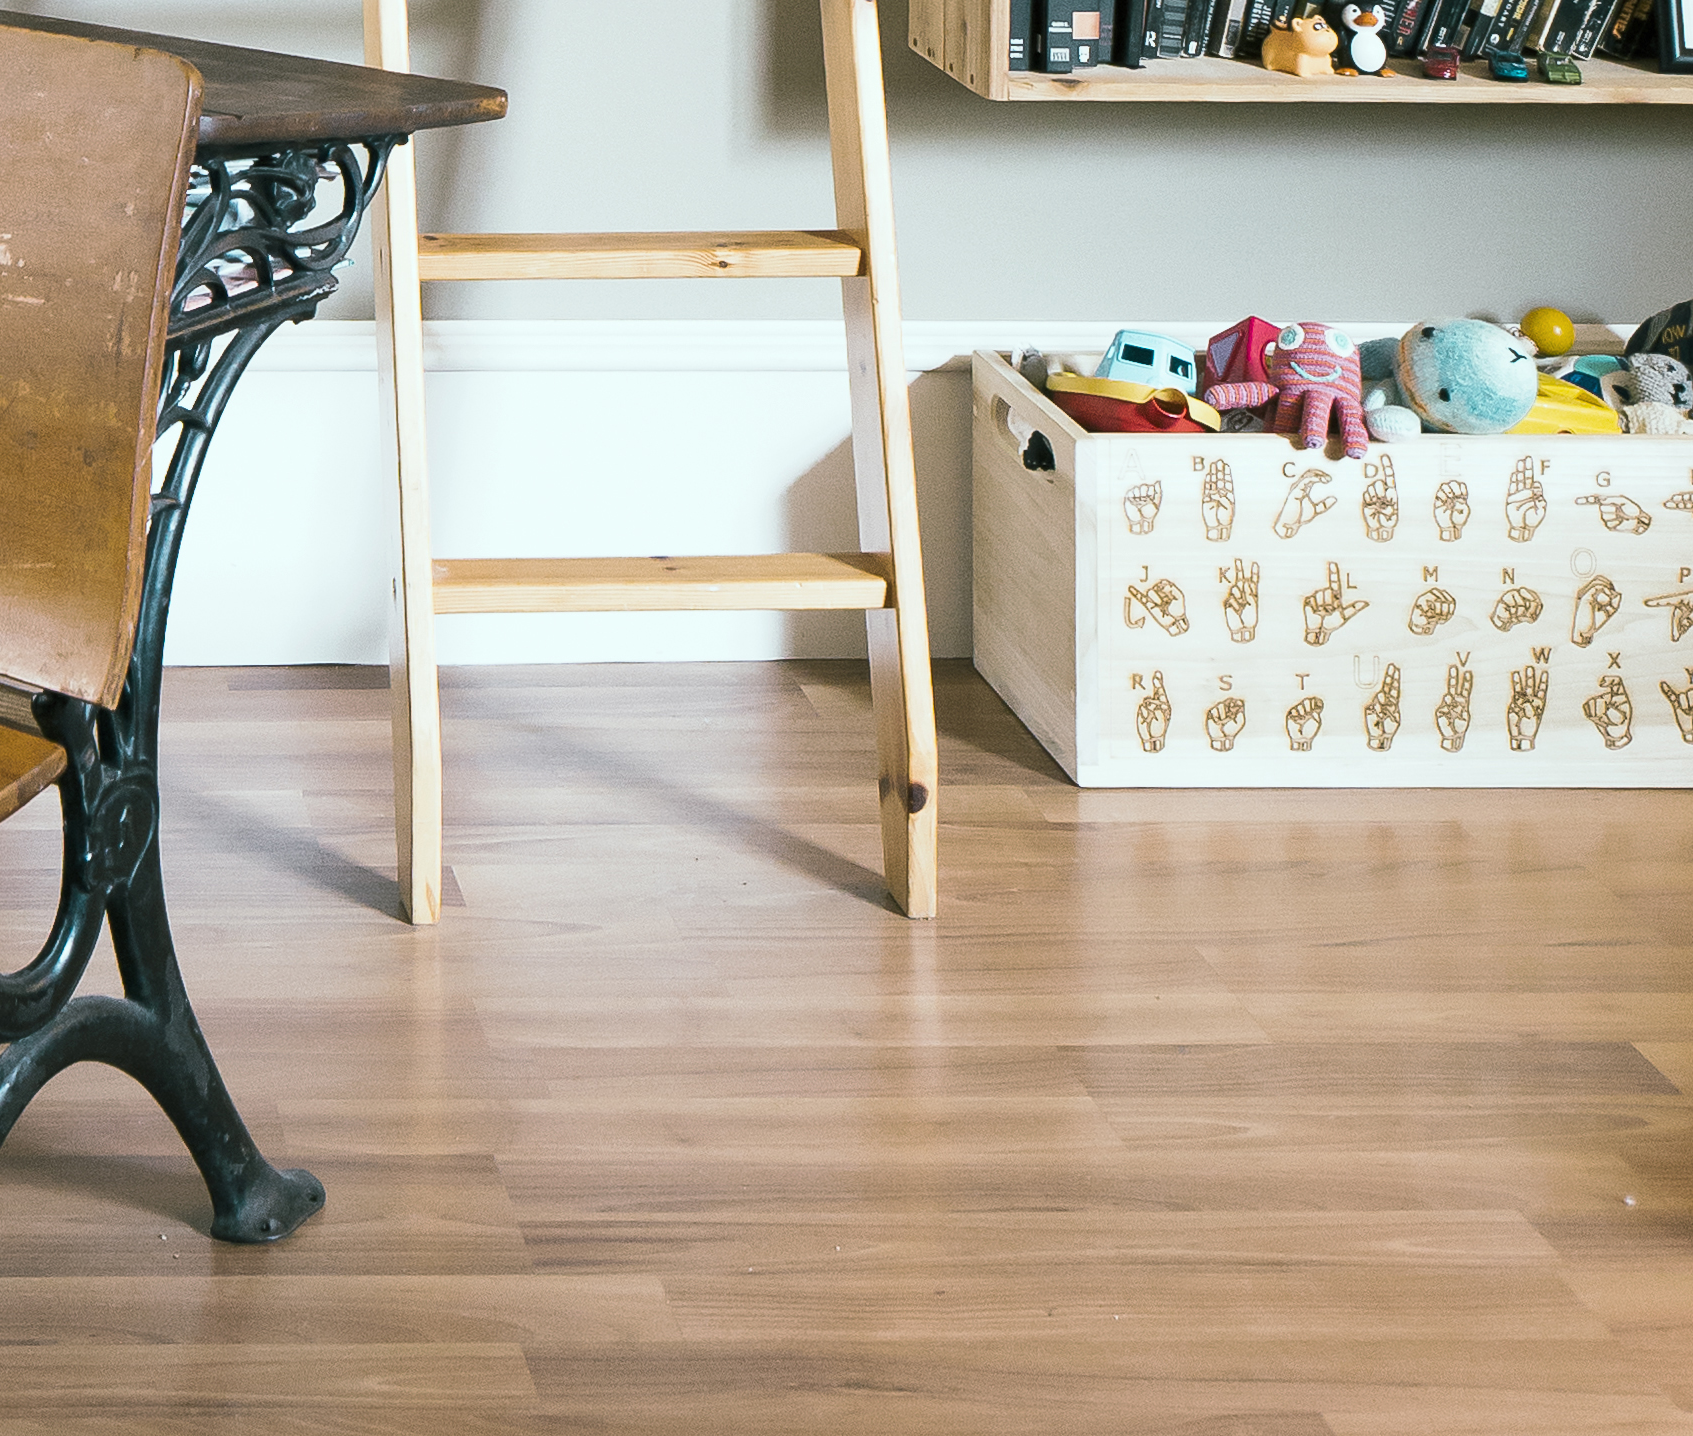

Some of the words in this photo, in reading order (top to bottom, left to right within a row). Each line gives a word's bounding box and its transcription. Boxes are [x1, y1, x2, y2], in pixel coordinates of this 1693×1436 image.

[1191, 456, 1205, 472] B
[1282, 462, 1297, 479] C
[1363, 463, 1378, 479] D
[1541, 458, 1552, 475] F
[1595, 471, 1611, 487] G
[1139, 565, 1149, 583] J
[1218, 566, 1232, 583] K
[1345, 572, 1357, 588] L
[1423, 566, 1438, 581] M
[1502, 568, 1514, 584] N
[1679, 566, 1691, 583] P
[1131, 673, 1144, 690] R
[1219, 674, 1233, 691] S
[1296, 674, 1309, 691] T
[1456, 651, 1471, 668] V
[1531, 647, 1552, 664] W
[1607, 652, 1622, 668] X
